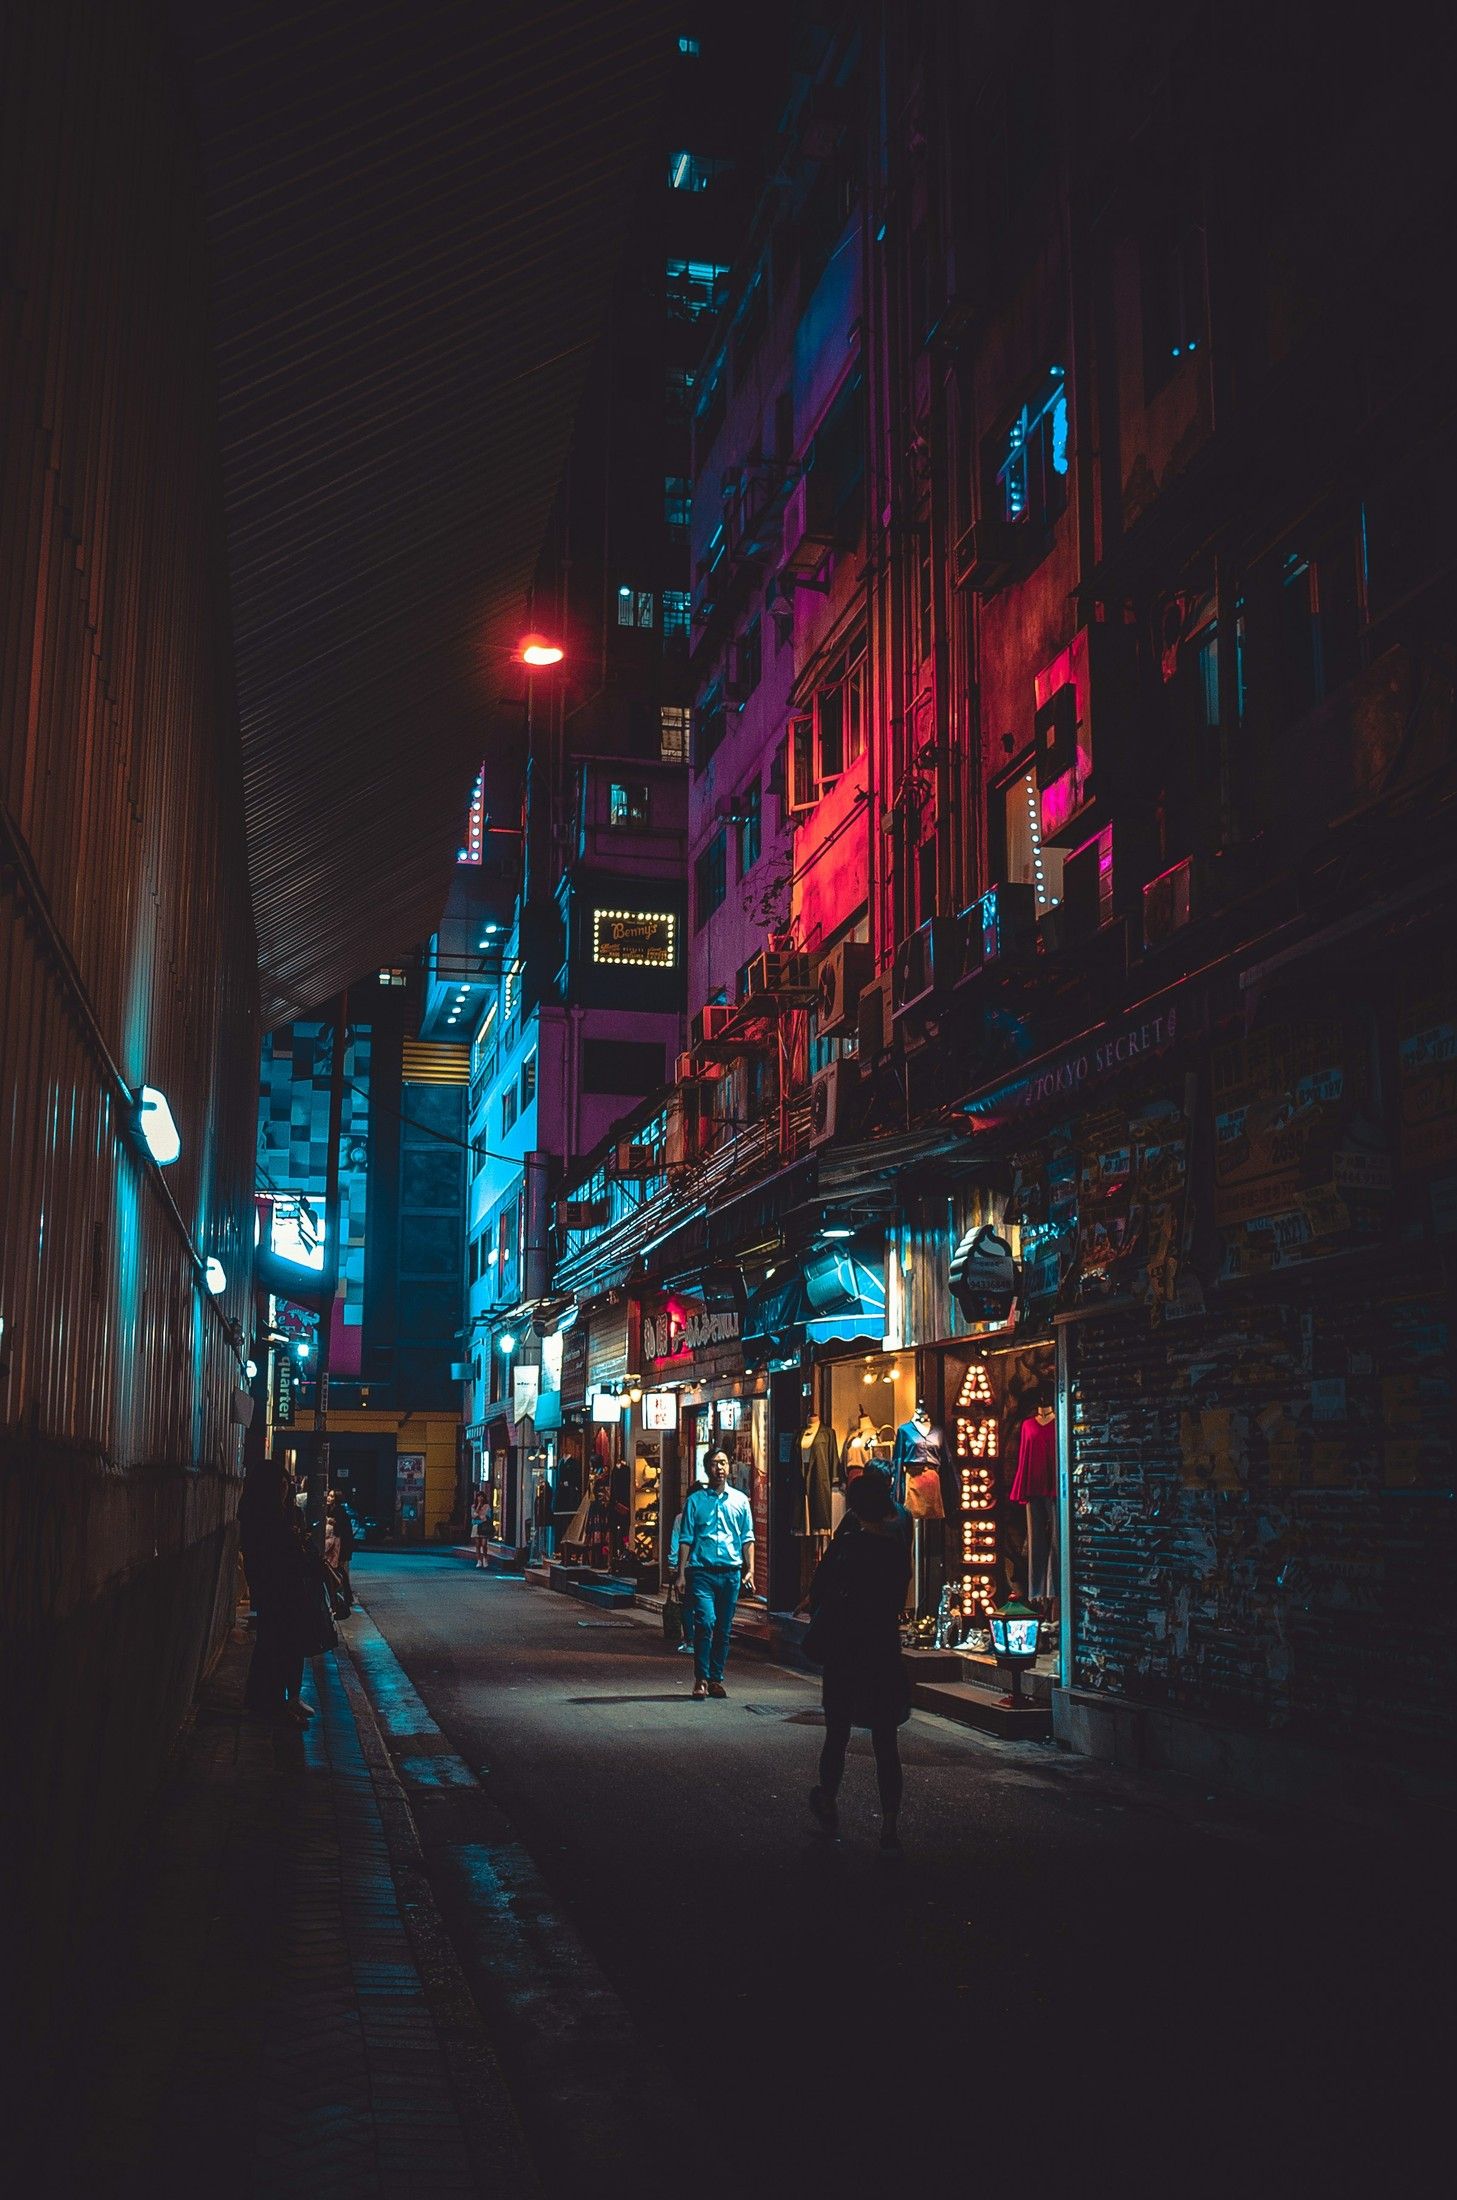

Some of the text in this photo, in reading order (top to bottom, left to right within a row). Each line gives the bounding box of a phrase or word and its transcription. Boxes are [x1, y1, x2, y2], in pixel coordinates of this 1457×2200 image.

[611, 922, 657, 940] Benny's
[1035, 1016, 1163, 1101] TOKYO SECRET
[277, 1356, 291, 1421] quarter
[955, 1364, 999, 1618] AMBER
